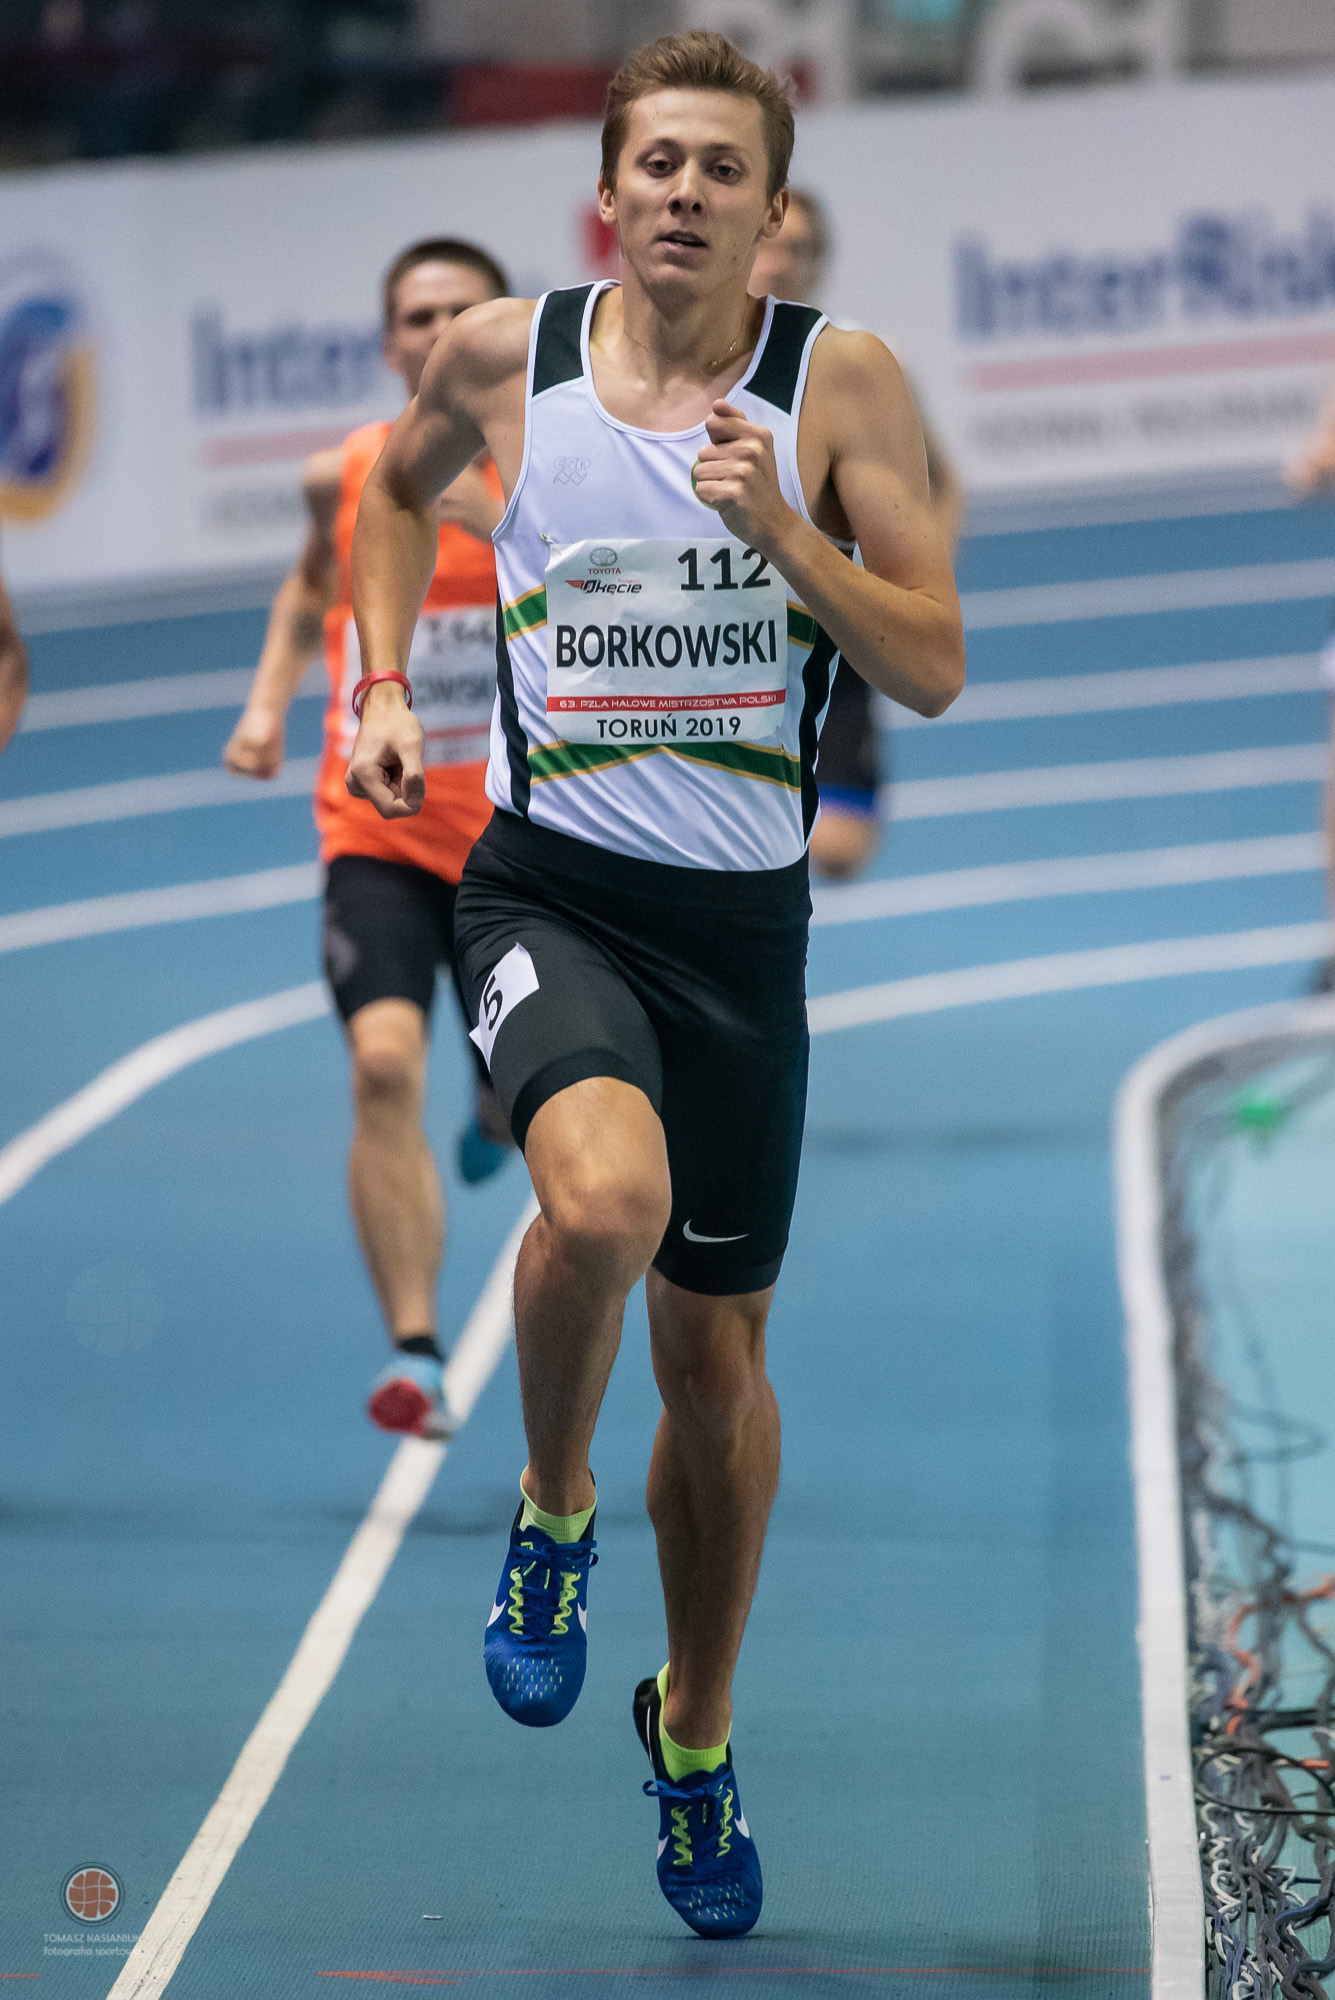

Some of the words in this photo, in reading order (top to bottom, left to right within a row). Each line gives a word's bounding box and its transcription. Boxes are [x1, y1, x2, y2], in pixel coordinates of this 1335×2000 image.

[677, 547, 771, 591] 112
[556, 620, 777, 668] BORKOWSKI
[580, 700, 609, 708] PZLA
[611, 699, 656, 708] HALOWE
[658, 697, 737, 708] MISTRZOSTWA
[739, 694, 777, 704] POLSKI
[597, 713, 677, 738] TORUŃ
[685, 716, 741, 737] 2019
[483, 973, 503, 1031] 5
